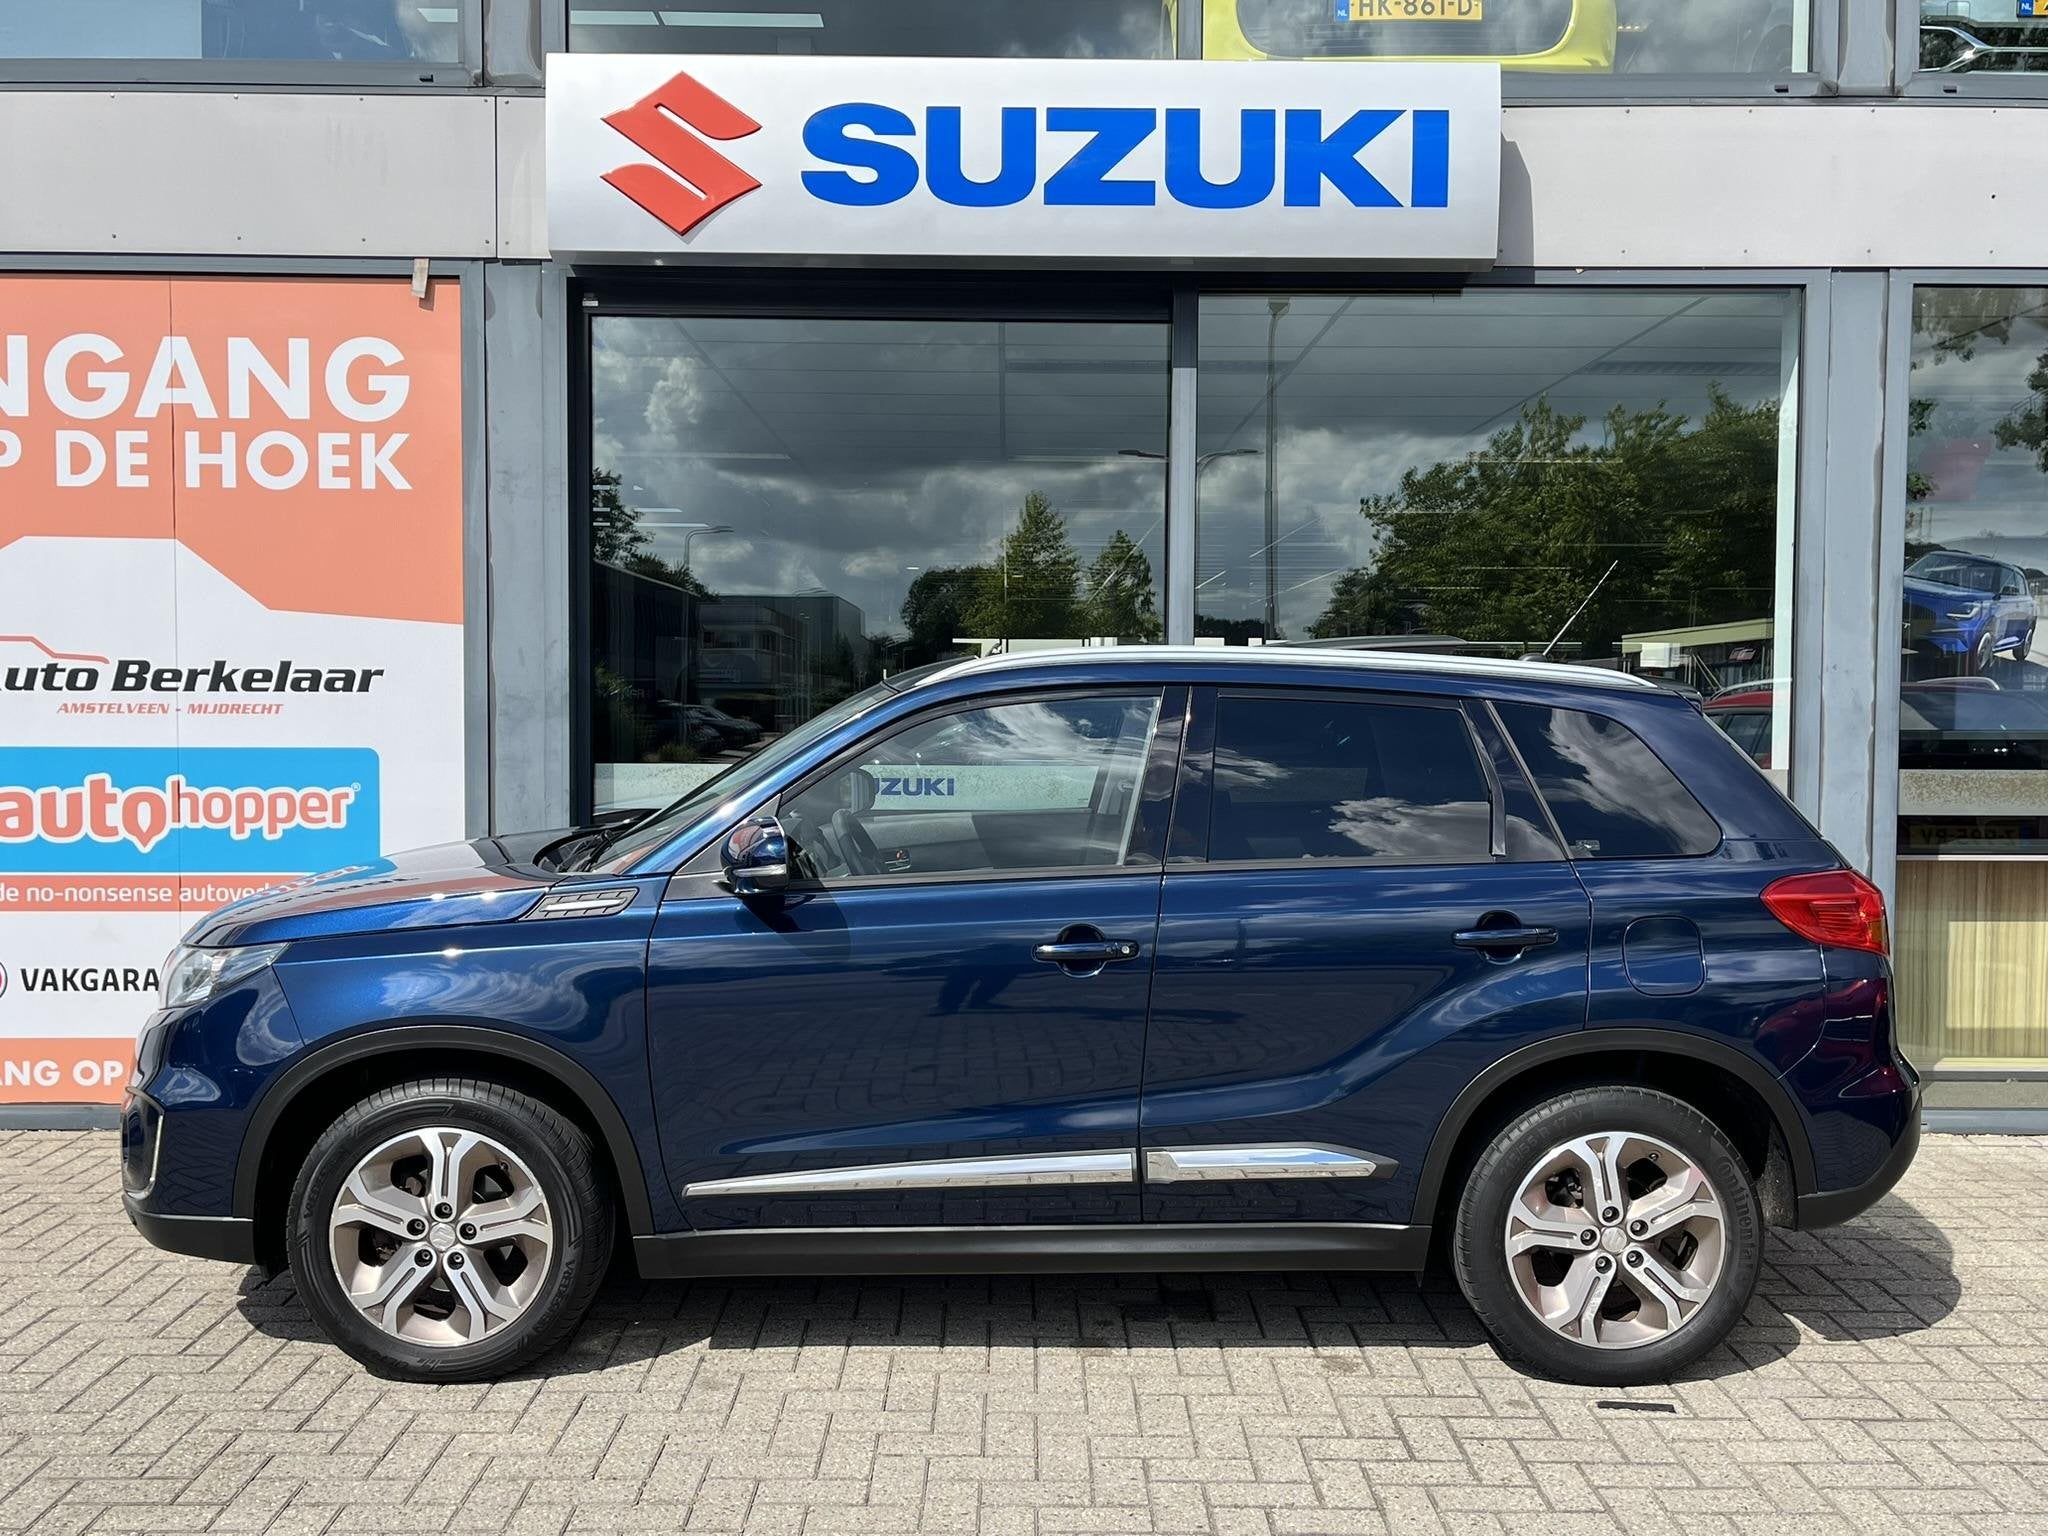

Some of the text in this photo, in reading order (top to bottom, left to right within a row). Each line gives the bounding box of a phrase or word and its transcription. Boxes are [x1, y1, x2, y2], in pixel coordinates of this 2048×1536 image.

[1337, 9, 1348, 17] NL
[2021, 2, 2032, 11] NL
[803, 103, 1450, 209] SUZUKI
[55, 430, 150, 488] DE
[184, 430, 413, 490] HOEK
[0, 660, 385, 693] uto Berkelaar
[57, 703, 170, 715] AMSTELVEEN
[187, 703, 285, 716] MIJDRECHT
[0, 882, 19, 902] de
[26, 886, 173, 903] no-nonsense
[20, 968, 160, 992] VAKGARA
[0, 1059, 124, 1087] NG OP
